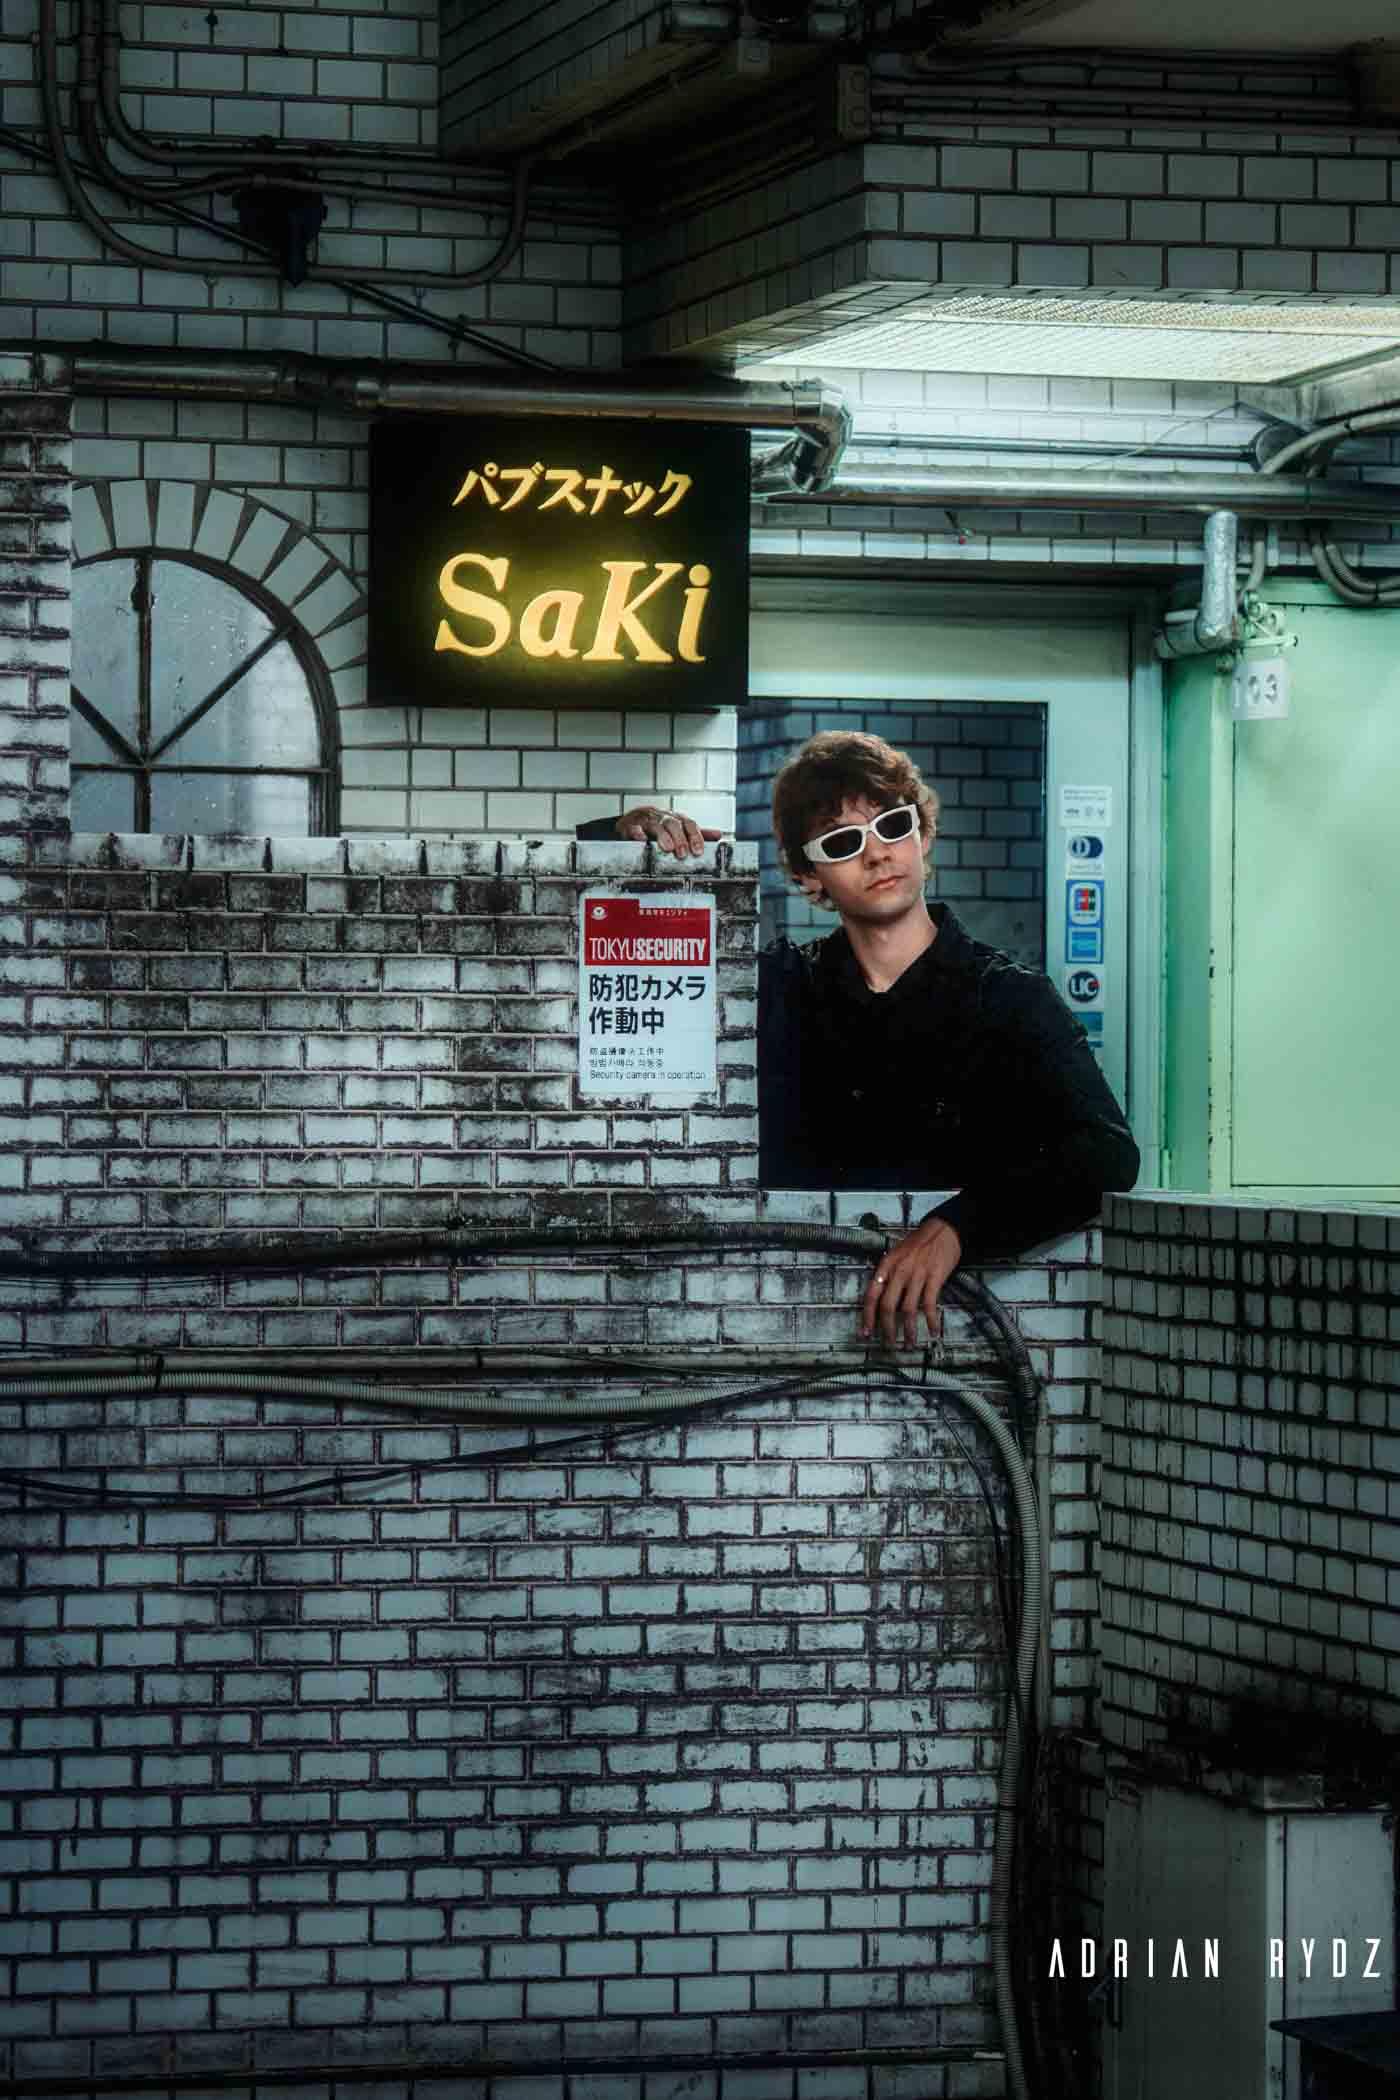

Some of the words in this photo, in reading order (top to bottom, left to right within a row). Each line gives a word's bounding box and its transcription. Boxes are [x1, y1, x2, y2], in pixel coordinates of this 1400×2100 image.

[452, 461, 693, 517] パブスナック
[435, 552, 712, 664] SaKi
[589, 974, 707, 1001] 防犯カメラ
[589, 1007, 665, 1035] 作動中
